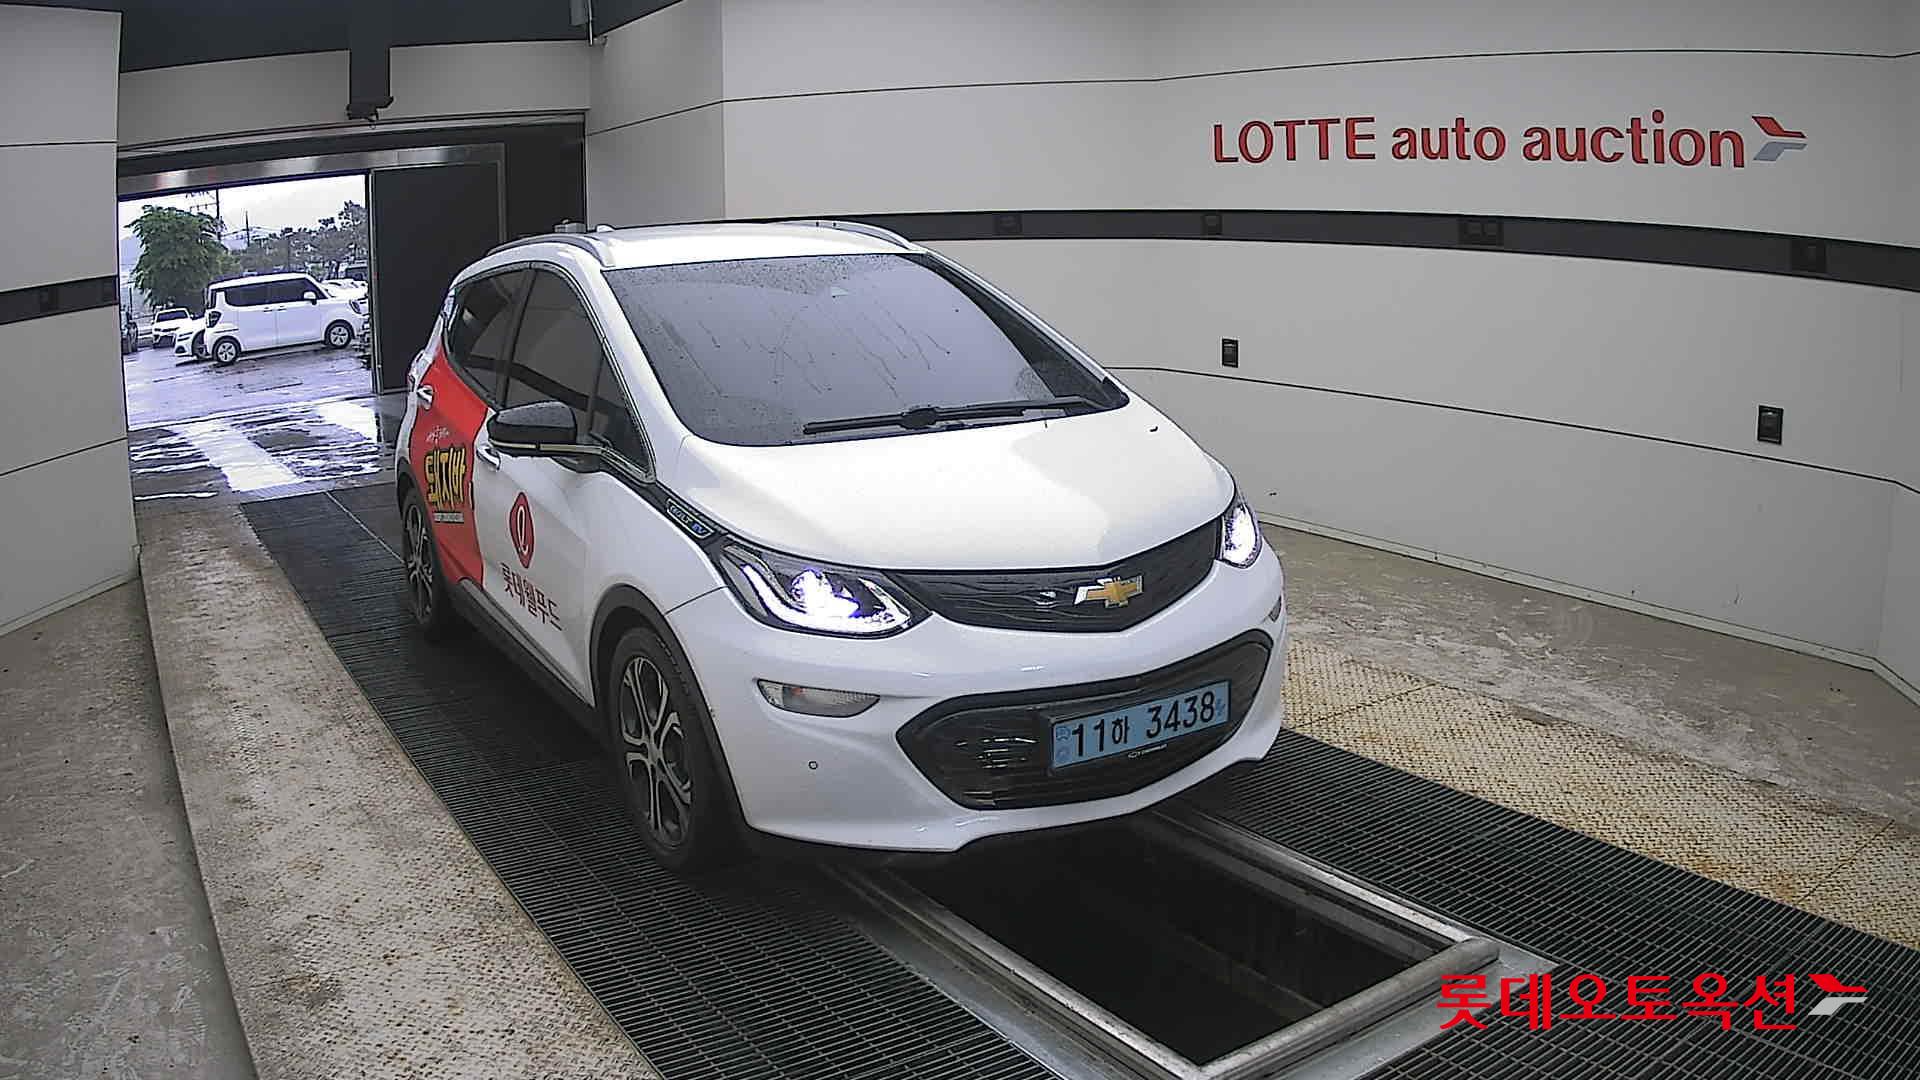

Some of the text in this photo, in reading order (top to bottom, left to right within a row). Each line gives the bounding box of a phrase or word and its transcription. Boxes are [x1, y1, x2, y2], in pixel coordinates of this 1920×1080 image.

[1213, 108, 1746, 169] LOTTE auto auction
[500, 561, 563, 632] 롯데웰푸드
[1072, 716, 1131, 757] 11하
[1146, 691, 1215, 739] 3438
